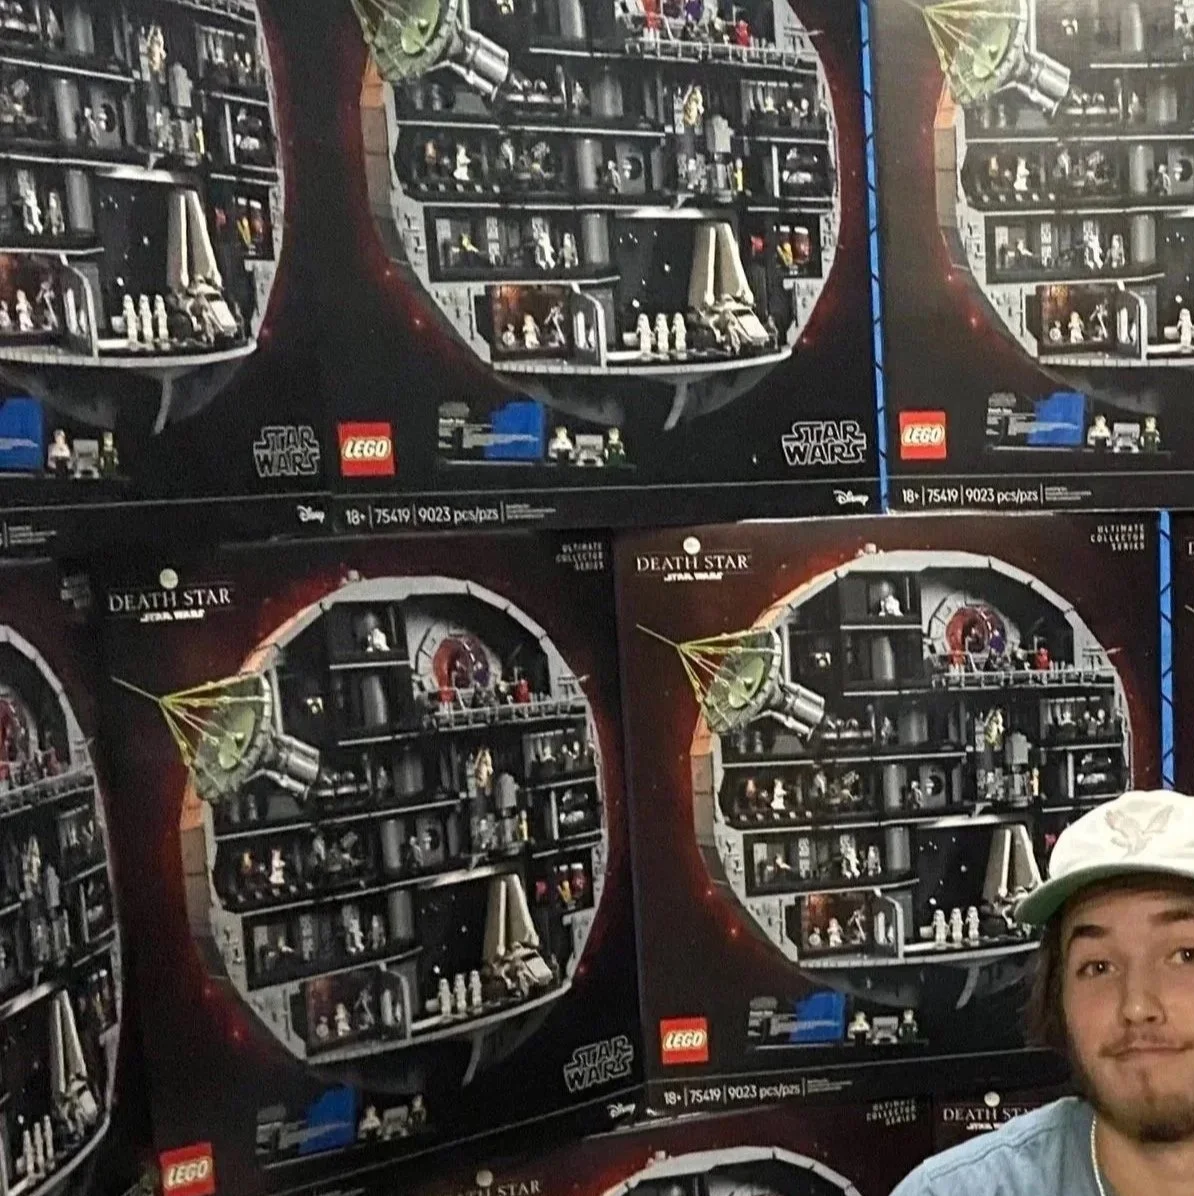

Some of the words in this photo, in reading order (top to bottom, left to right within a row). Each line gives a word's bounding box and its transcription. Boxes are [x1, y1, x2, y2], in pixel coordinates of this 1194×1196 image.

[254, 425, 319, 452] STAR
[782, 420, 866, 442] STAR
[901, 423, 945, 446] LEGO
[342, 437, 391, 461] LEGO
[783, 441, 867, 465] WARS
[256, 450, 320, 477] WARS
[902, 490, 919, 503] 18+
[927, 488, 958, 502] 75419
[965, 488, 995, 502] 9023
[997, 488, 1038, 504] pcs/pzs
[346, 510, 366, 525] 18+
[375, 507, 410, 524] 75419
[418, 506, 451, 522] 9023
[454, 506, 499, 524] pcs/pzs
[1090, 533, 1145, 543] COLLECTOR
[1112, 542, 1145, 551] SERIES
[636, 554, 697, 572] DEATH
[704, 554, 748, 570] STAR
[108, 591, 178, 612] DEATH
[183, 587, 231, 606] STAR
[664, 1029, 707, 1051] LEGO
[564, 1035, 634, 1070] STAR
[564, 1053, 635, 1092] WARS
[664, 1091, 682, 1105] 18+
[690, 1089, 721, 1103] 75419
[728, 1085, 757, 1100] 9023
[759, 1083, 801, 1100] pcs/pzs
[943, 1108, 998, 1122] DEATH
[165, 1156, 213, 1191] LEGO
